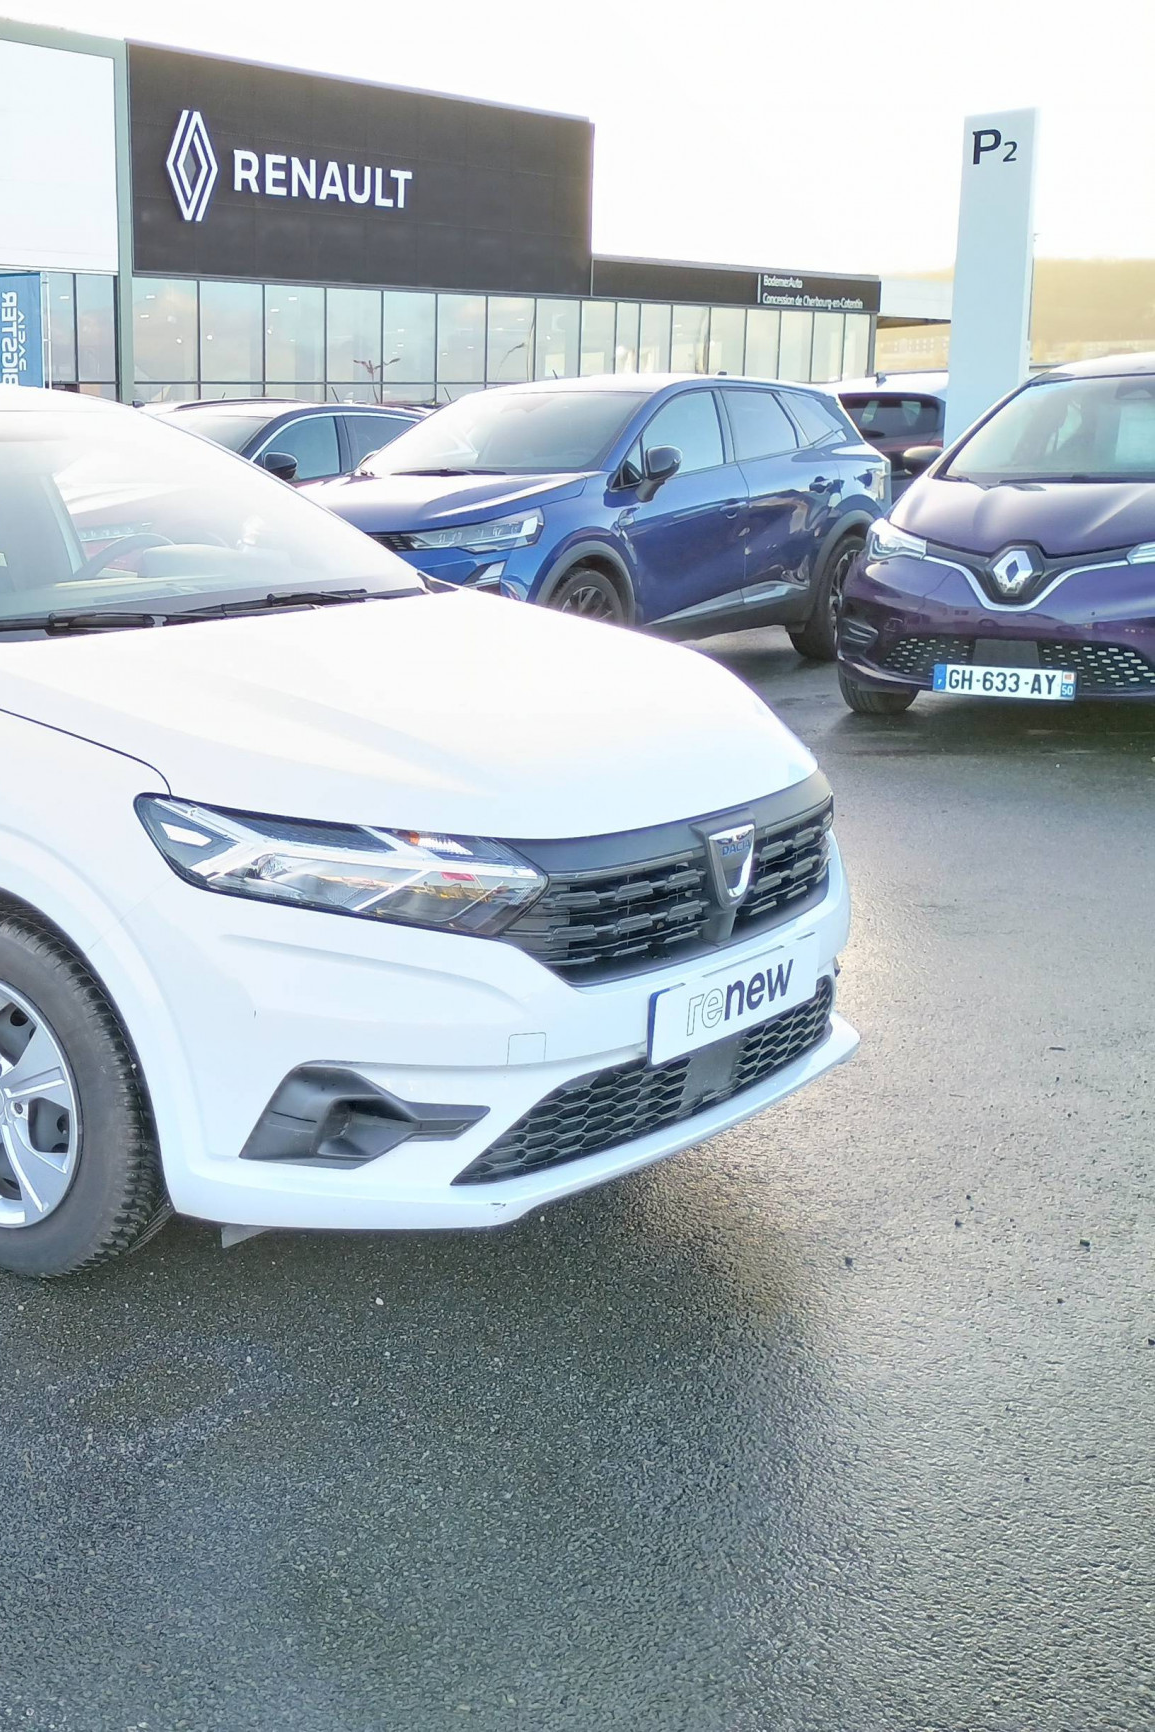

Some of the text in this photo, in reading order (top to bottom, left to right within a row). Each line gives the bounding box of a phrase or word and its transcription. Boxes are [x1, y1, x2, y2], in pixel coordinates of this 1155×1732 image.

[233, 149, 413, 209] RENAULT
[762, 293, 863, 310] Concession de Cherbourg-en-Cotentin
[948, 669, 1057, 695] GH-633-AY
[1061, 684, 1073, 696] 50
[686, 959, 794, 1037] renew
